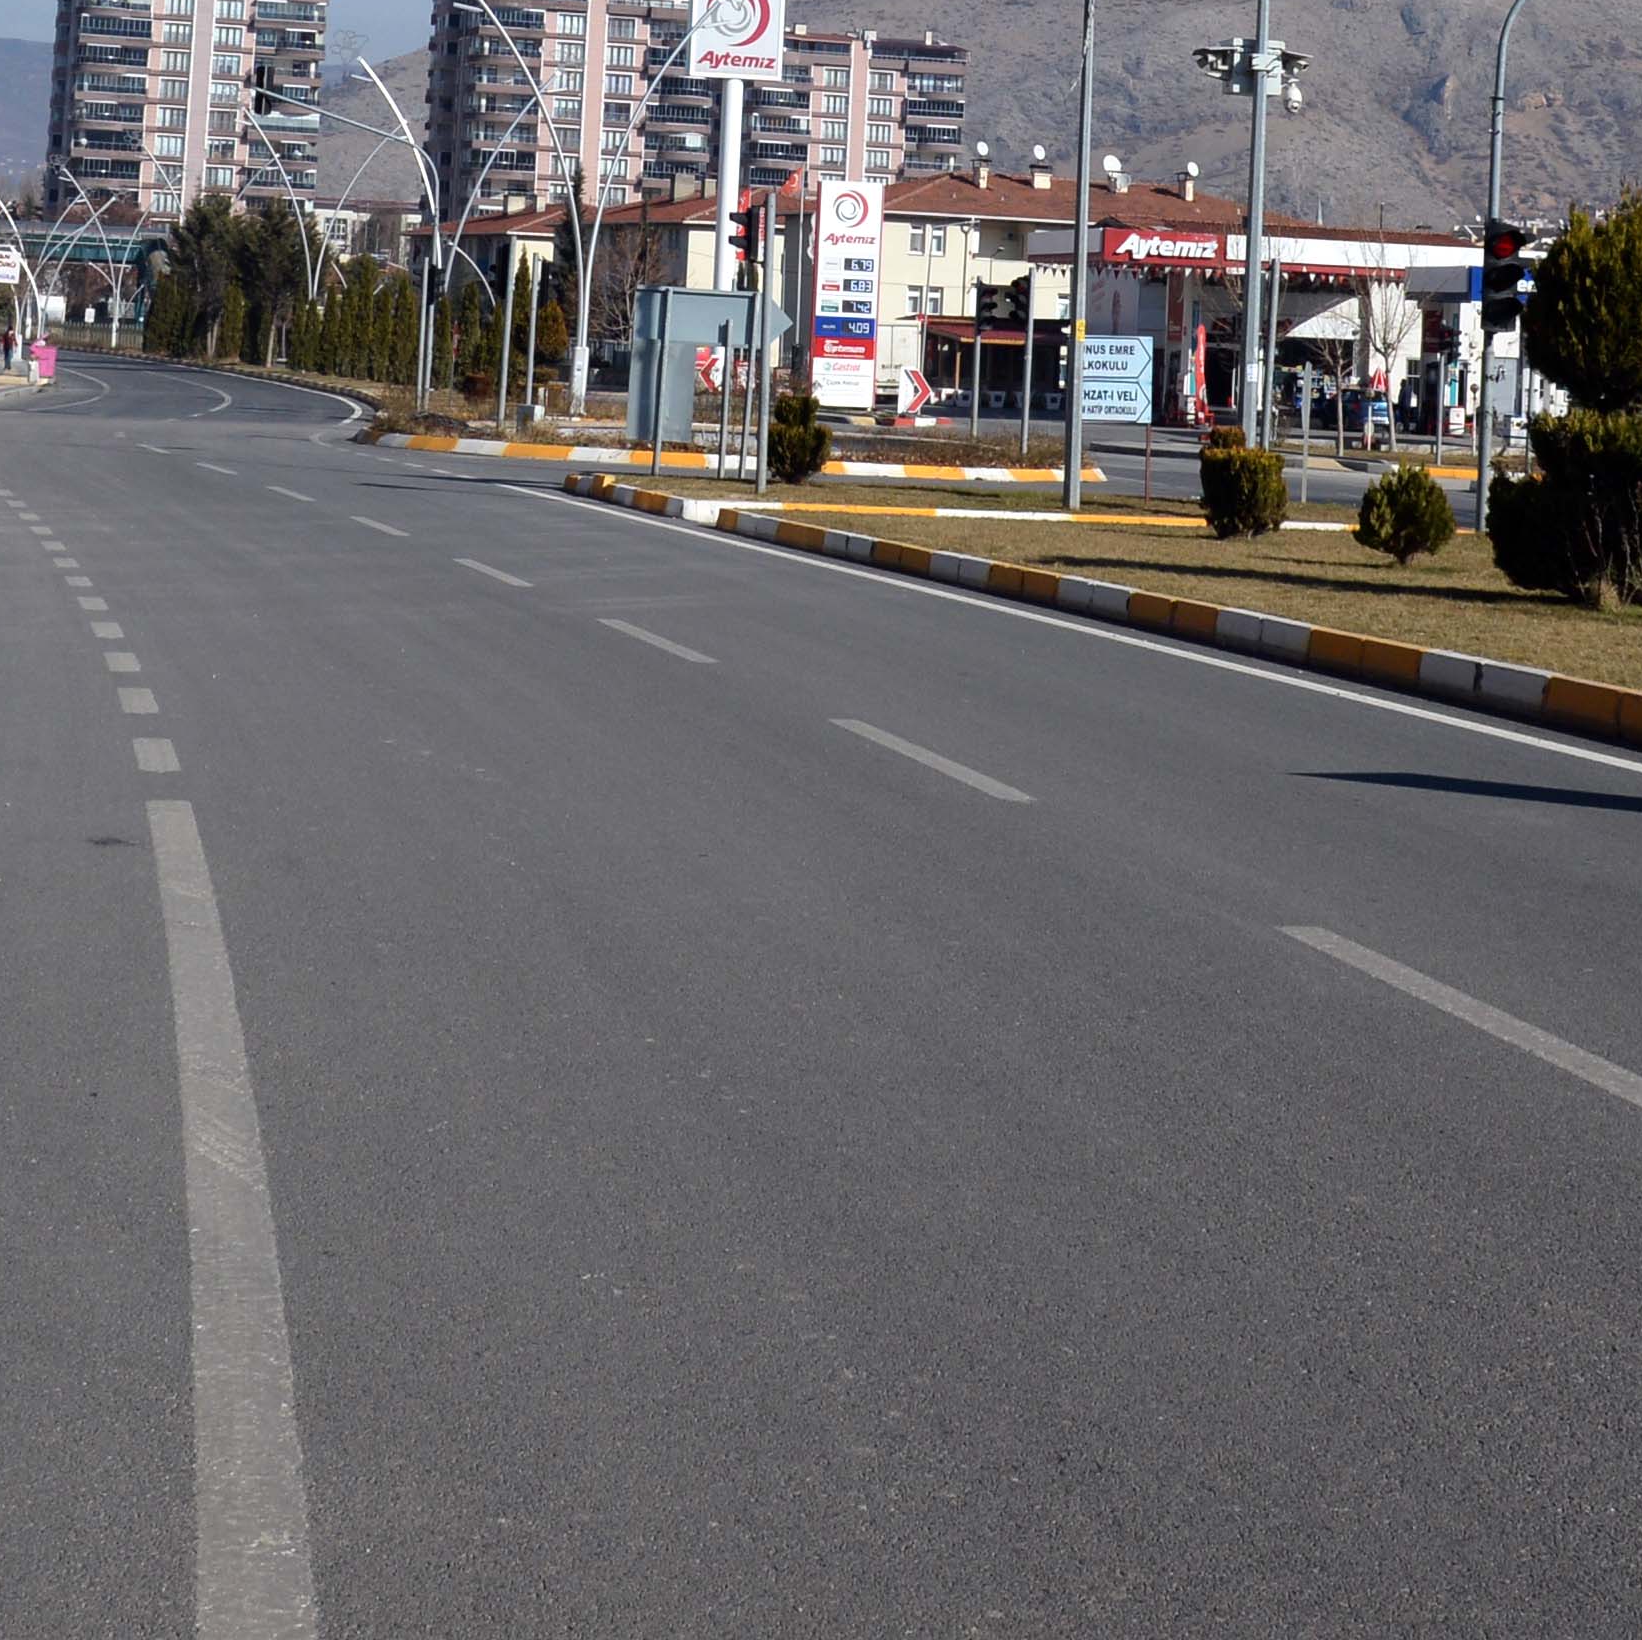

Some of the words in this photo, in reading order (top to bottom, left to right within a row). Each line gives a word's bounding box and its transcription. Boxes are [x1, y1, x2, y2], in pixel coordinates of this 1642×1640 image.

[698, 50, 777, 69] Aytemiz
[823, 233, 876, 245] Aytemiz
[1115, 232, 1219, 260] Aytemiz
[848, 322, 870, 334] 4.09
[1083, 344, 1106, 355] NUS
[1109, 345, 1136, 355] EMRE
[1082, 360, 1128, 370] LKOKULU
[1083, 389, 1114, 400] HZAT-I
